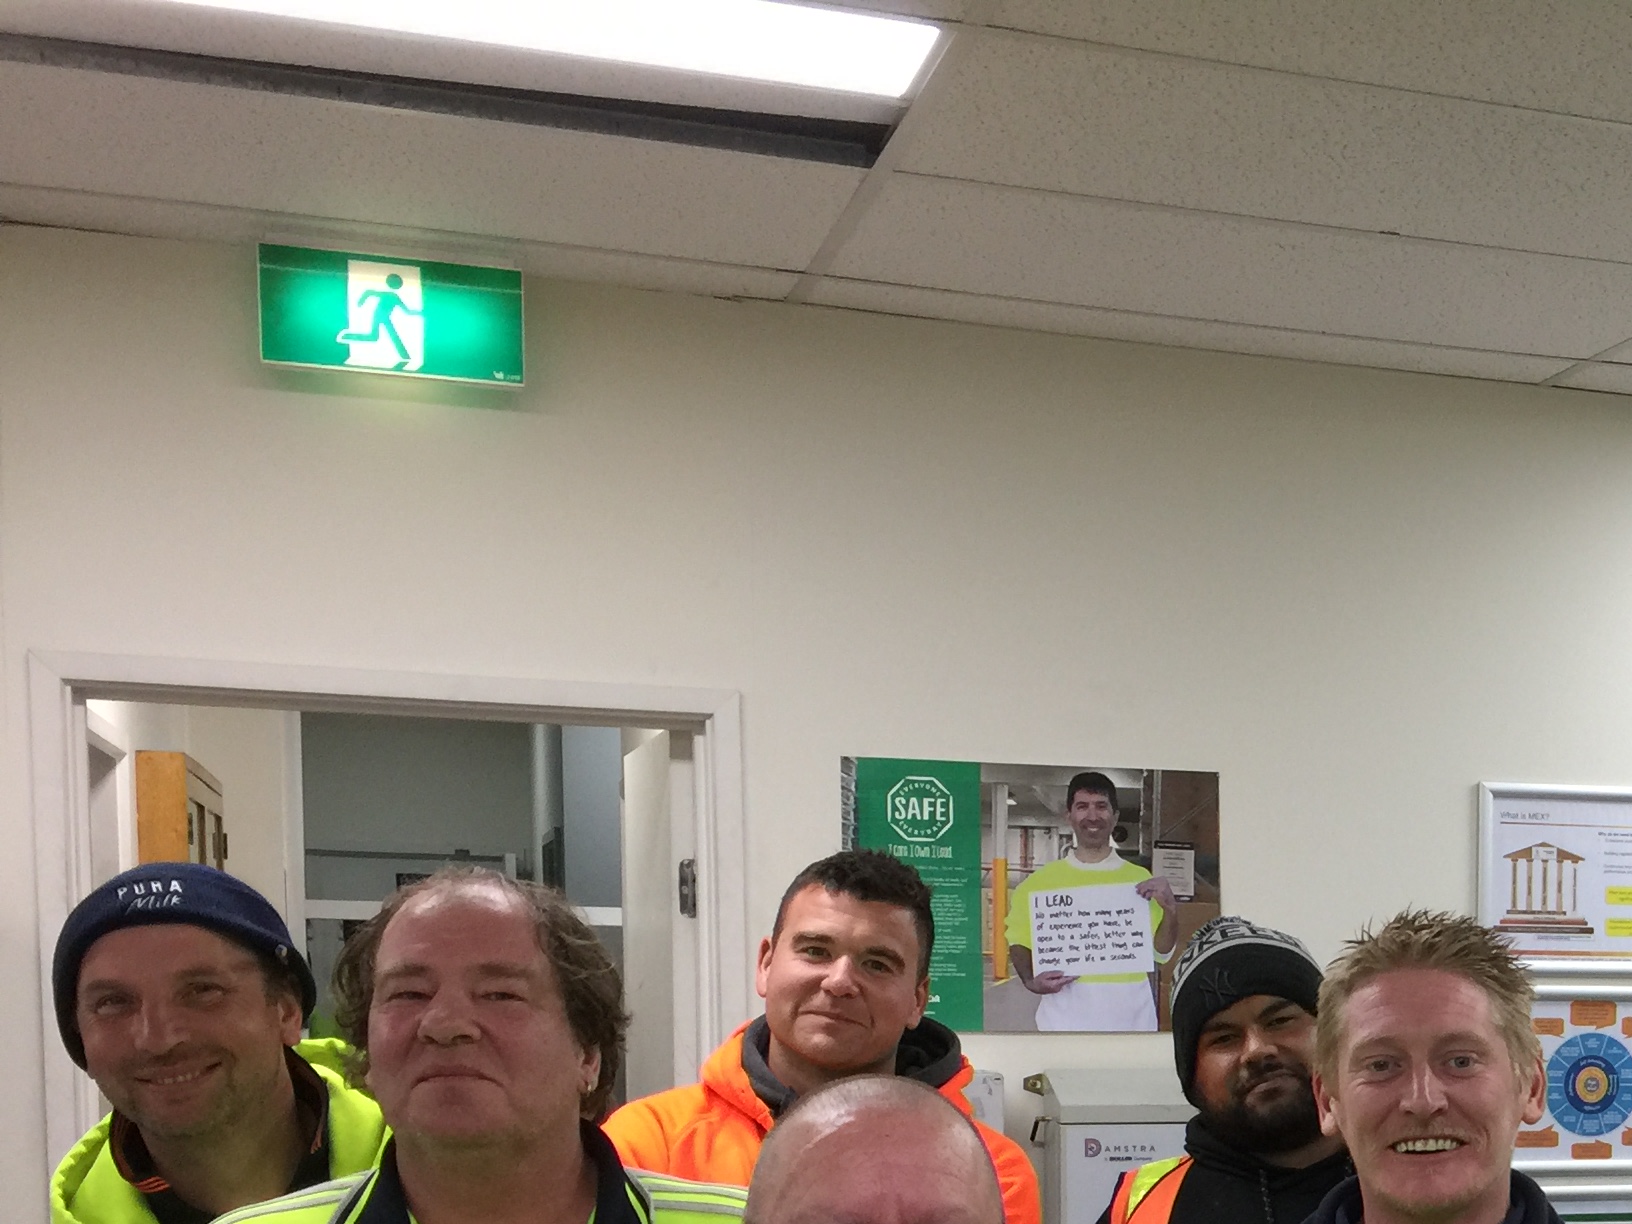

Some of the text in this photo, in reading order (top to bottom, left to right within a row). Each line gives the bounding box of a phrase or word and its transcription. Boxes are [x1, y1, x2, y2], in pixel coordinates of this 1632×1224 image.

[898, 782, 941, 797] EVERYONE
[894, 797, 947, 821] SAFE
[898, 821, 942, 836] EVERYDAY
[125, 894, 182, 916] Milk
[1034, 894, 1073, 908] I LEAD
[1049, 911, 1073, 919] matter
[1115, 907, 1135, 915] years
[1036, 922, 1044, 931] of
[1049, 922, 1082, 931] experience
[1087, 921, 1099, 929] you
[1037, 935, 1053, 943] open
[1057, 933, 1065, 941] to
[1104, 930, 1126, 938] better
[1037, 946, 1064, 955] because
[1068, 944, 1080, 952] the
[1038, 957, 1061, 966] change
[1065, 956, 1081, 965] your
[1084, 1138, 1156, 1157] DAMSTRA
